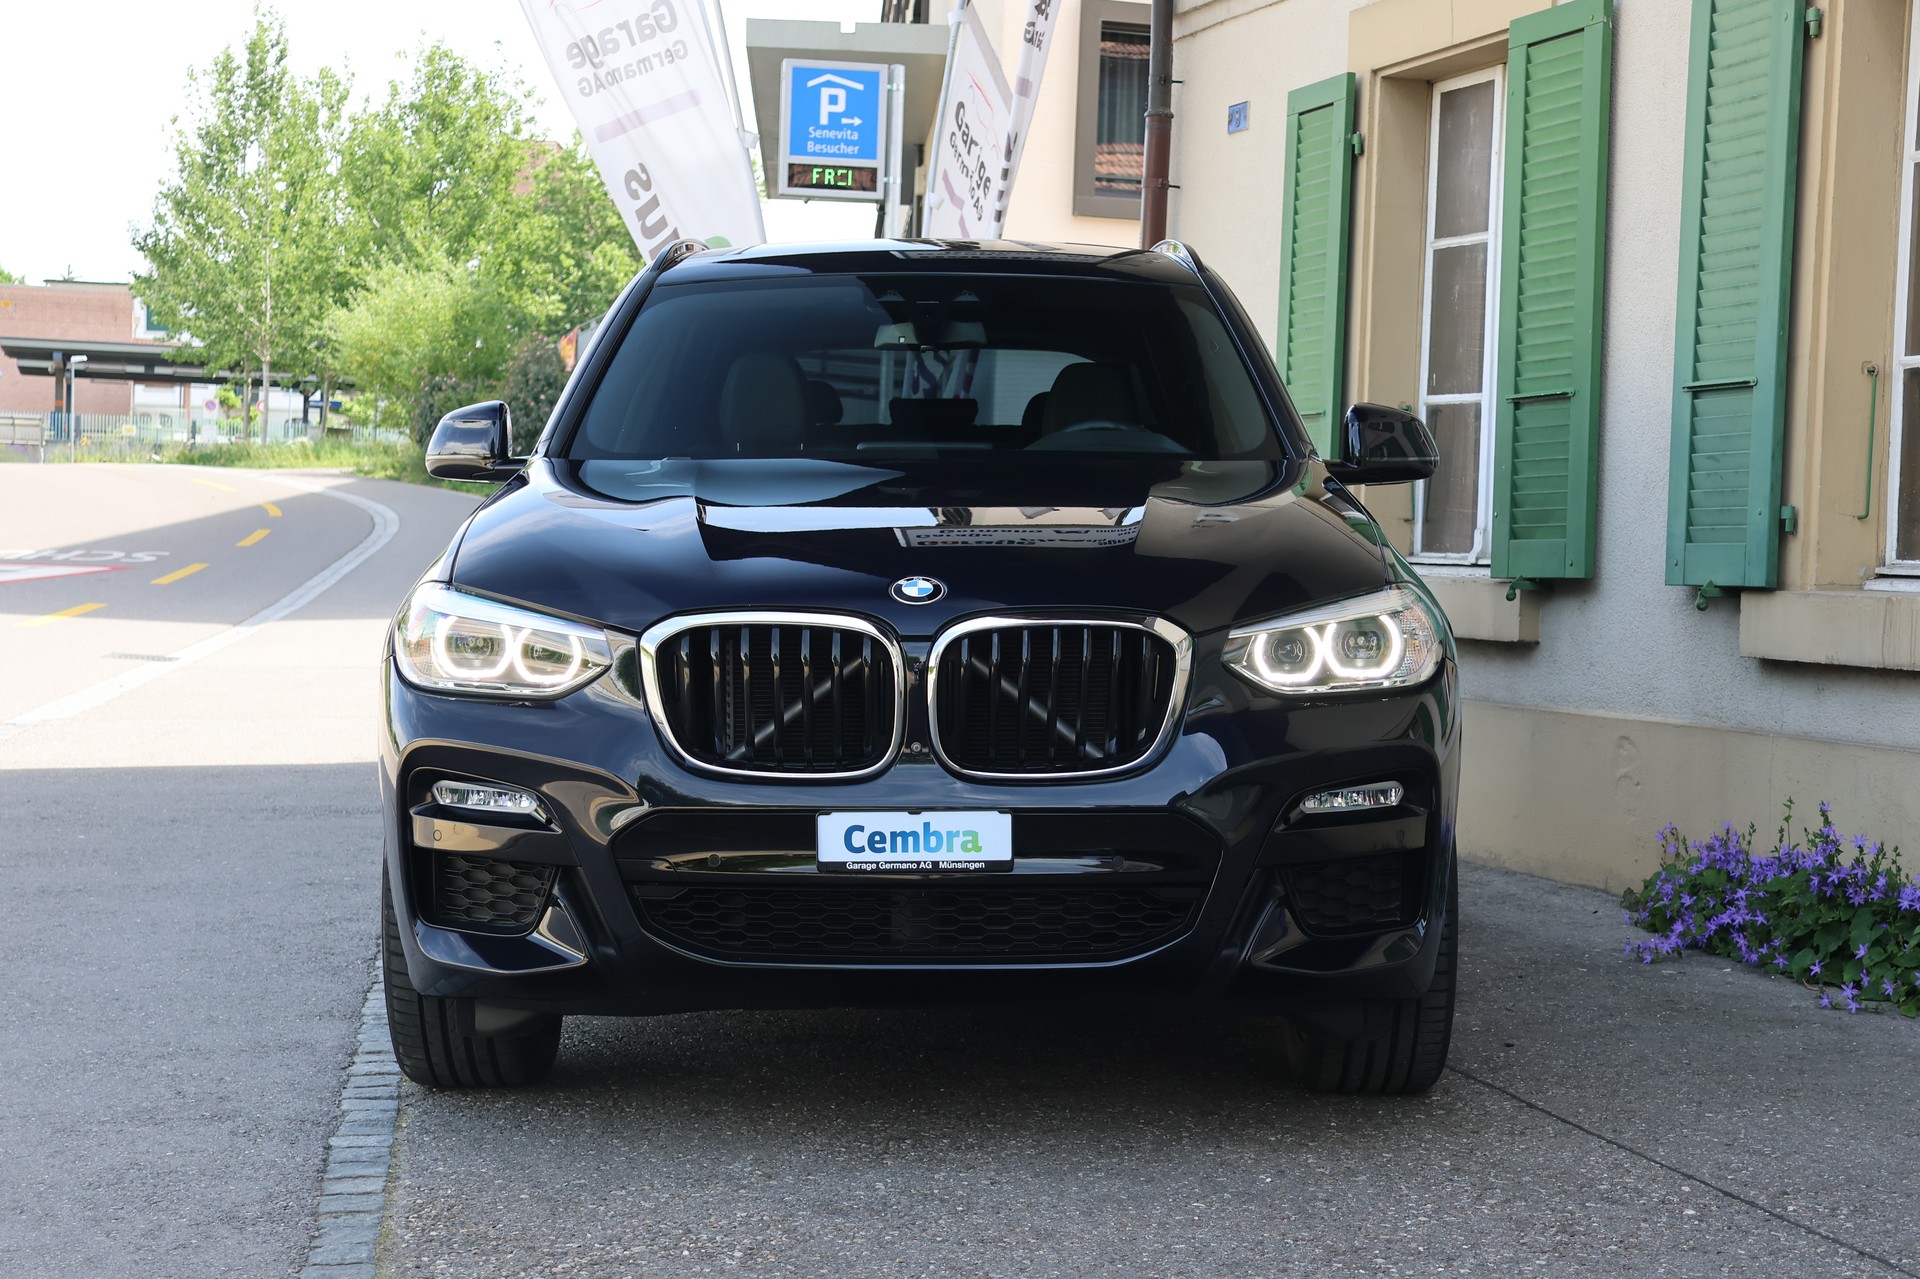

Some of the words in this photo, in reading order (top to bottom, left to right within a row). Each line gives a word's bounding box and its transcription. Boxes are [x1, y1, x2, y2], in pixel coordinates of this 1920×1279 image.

[819, 87, 847, 125] P
[808, 126, 859, 140] Senevita
[807, 141, 859, 154] Besucher
[843, 821, 983, 854] Cembra
[846, 862, 877, 871] Garage
[879, 861, 917, 870] Germano
[919, 861, 933, 869] AG
[939, 861, 985, 870] Münsingen
